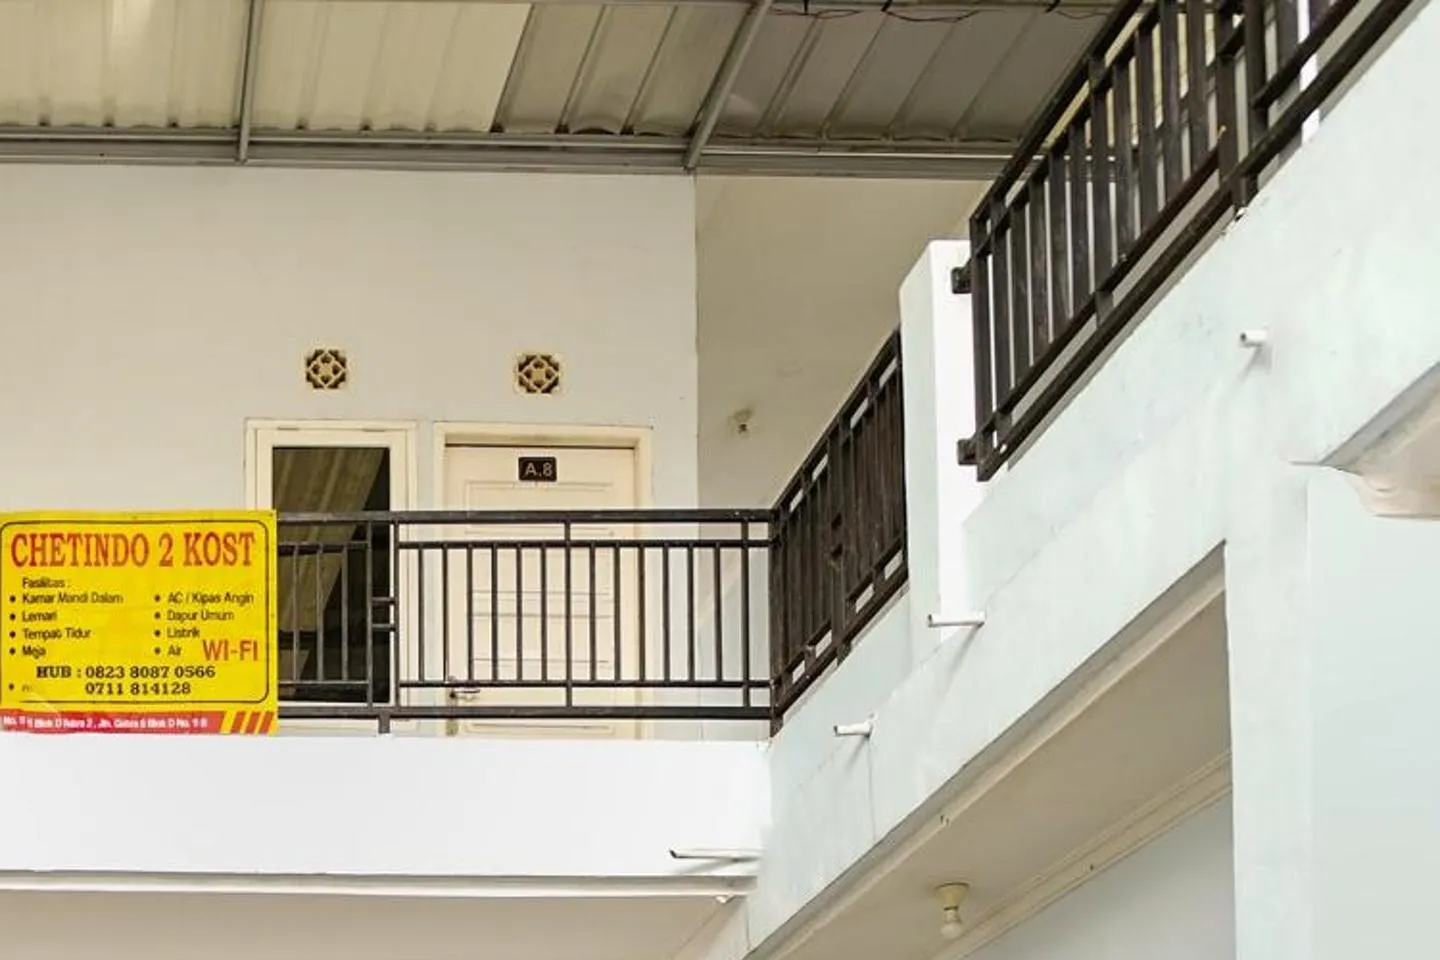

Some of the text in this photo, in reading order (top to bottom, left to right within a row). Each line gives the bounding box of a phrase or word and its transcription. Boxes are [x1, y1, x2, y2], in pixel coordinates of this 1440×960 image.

[523, 461, 553, 478] A.8
[10, 531, 256, 568] CHETINDO 2 KOST
[22, 592, 55, 604] Kamar
[91, 591, 124, 604] Dalam
[168, 591, 183, 604] AC
[192, 592, 222, 605] Kipas
[224, 591, 254, 607] Angin
[167, 609, 198, 623] Dapur
[65, 626, 91, 639] Tidur
[168, 644, 182, 656] Air
[202, 639, 259, 661] WI-FI
[36, 665, 72, 679] HUB
[85, 665, 125, 679] 0823
[129, 665, 171, 679] 8087
[174, 664, 216, 678] 0566
[85, 681, 192, 695] 0711 814128
